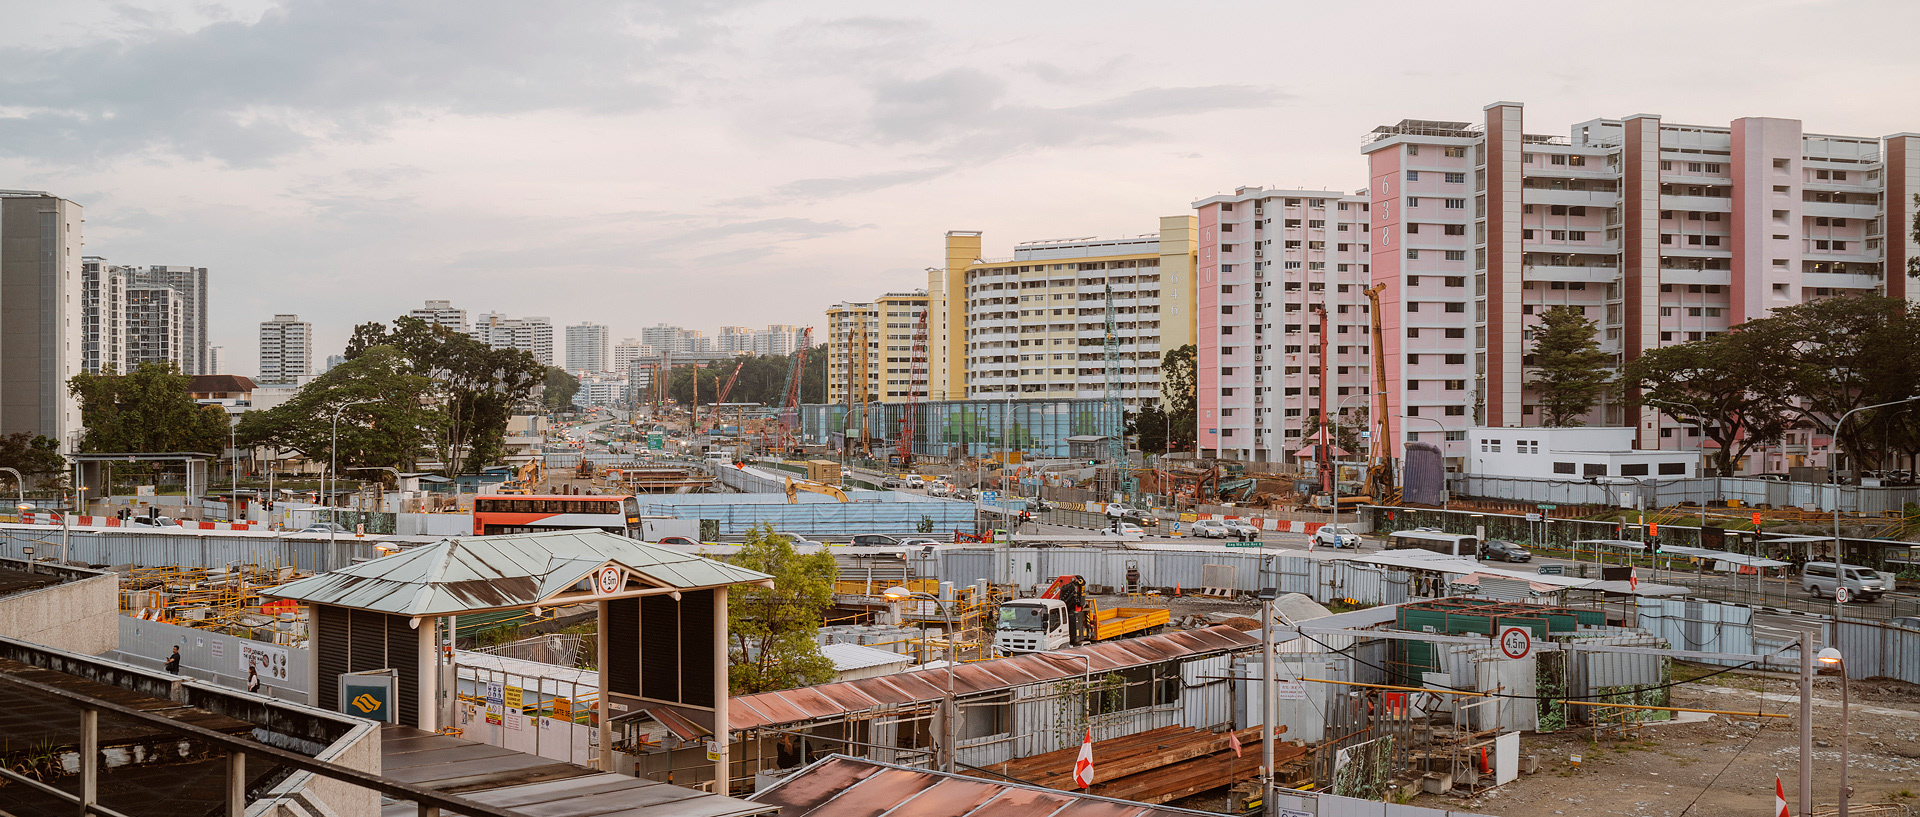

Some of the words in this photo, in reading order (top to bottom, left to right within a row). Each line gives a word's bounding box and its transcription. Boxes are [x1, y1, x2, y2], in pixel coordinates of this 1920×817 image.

[1382, 175, 1390, 246] 638
[1170, 271, 1179, 316] 646
[603, 576, 616, 585] 4.5m
[1506, 638, 1525, 649] 4.5m
[554, 708, 564, 716] GATE
